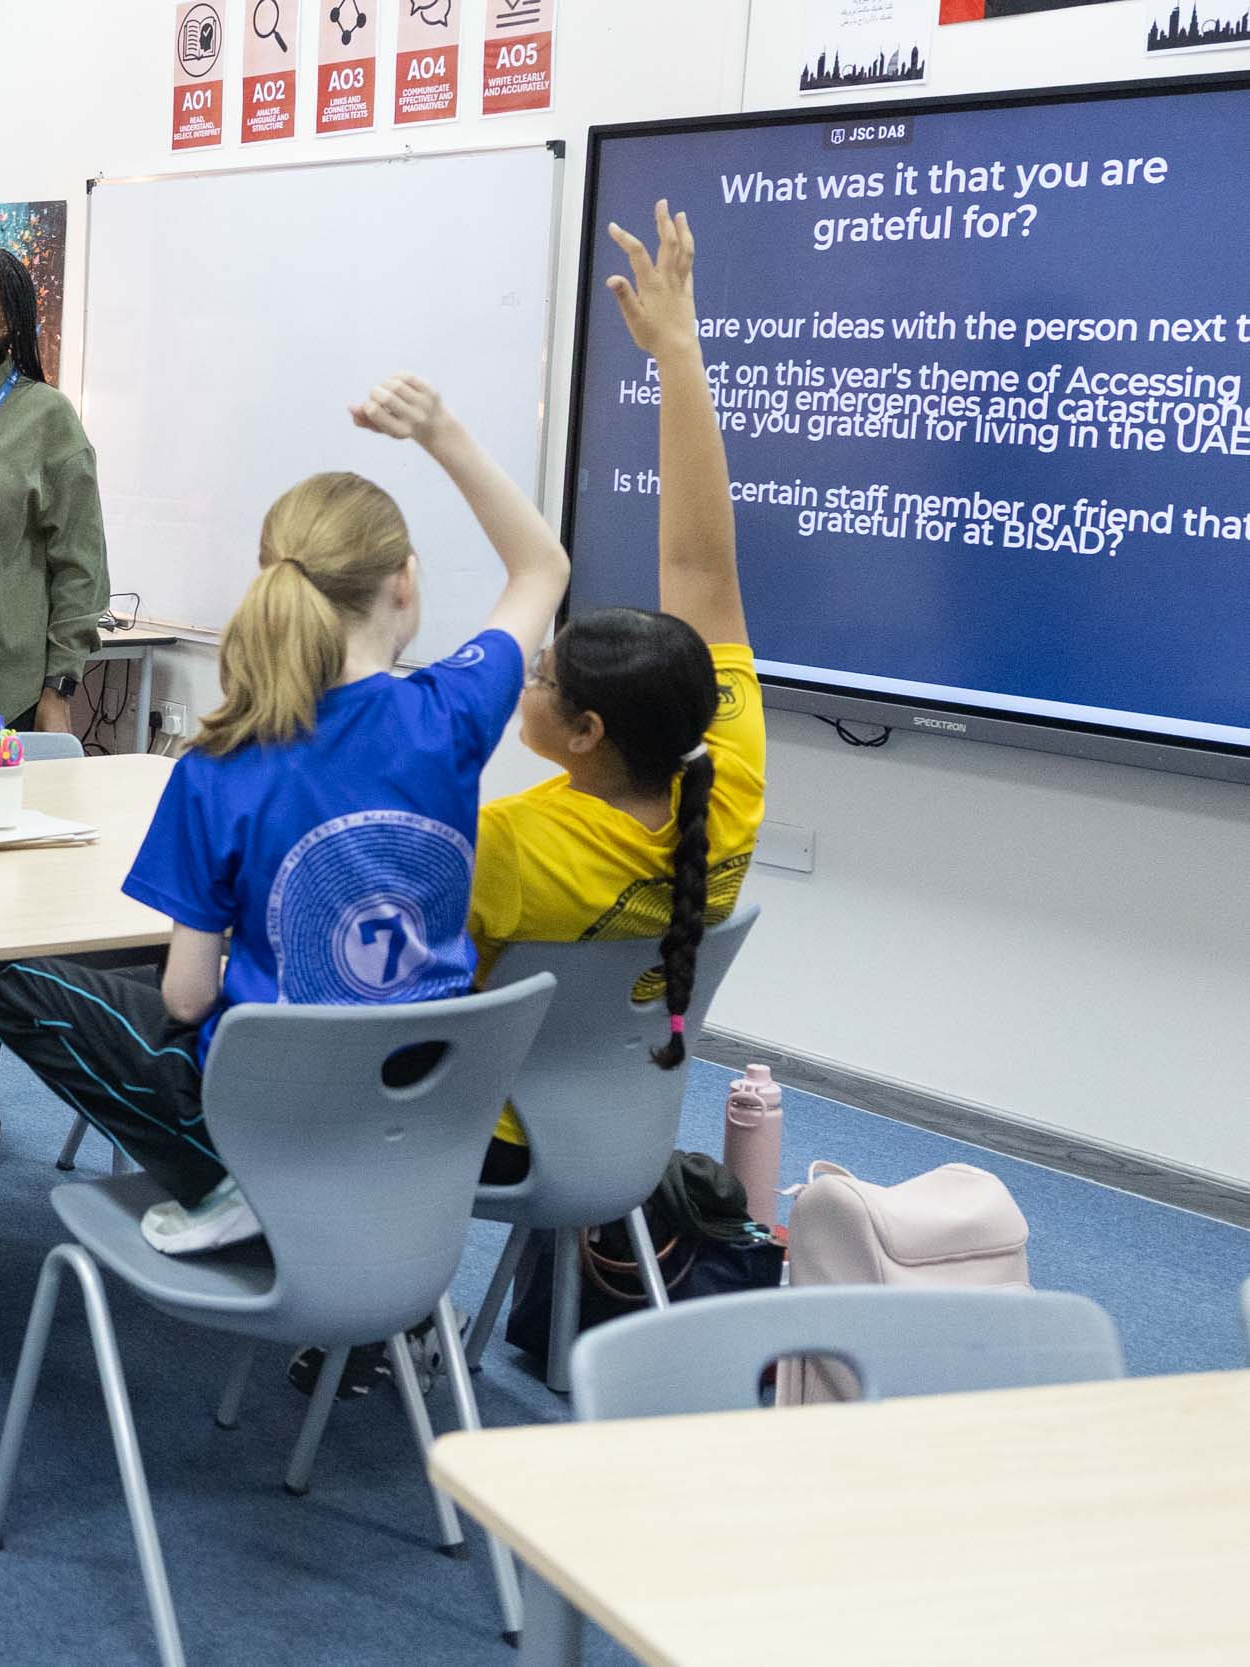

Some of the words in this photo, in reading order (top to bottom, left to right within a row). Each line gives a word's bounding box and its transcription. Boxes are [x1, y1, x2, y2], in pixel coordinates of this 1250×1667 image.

[407, 55, 447, 80] AO4
[496, 43, 538, 70] AO5
[252, 79, 286, 103] AO2
[328, 67, 365, 92] AO3
[402, 83, 450, 97] COMMUNICATE
[484, 87, 501, 97] AND
[501, 81, 550, 95] ACCURATELY
[488, 76, 512, 87] WRITE
[512, 71, 546, 84] CLEARLY
[182, 89, 212, 111] AO1
[323, 102, 367, 115] CONNECTIONS
[348, 95, 361, 104] AND
[399, 94, 439, 105] EFFECTIVELY
[439, 92, 454, 101] AND
[402, 101, 449, 112] IMAGINATIVELY
[277, 112, 289, 121] AND
[322, 112, 350, 123] BETWEEN
[350, 109, 368, 119] TEXTS
[849, 126, 875, 141] JSC
[878, 124, 906, 140] DA8
[721, 171, 808, 203] What
[817, 171, 885, 200] was
[894, 162, 918, 196] it
[928, 160, 1006, 195] that
[1014, 161, 1088, 198] you
[1101, 156, 1168, 186] are
[813, 206, 953, 250] grateful
[963, 204, 1038, 239] for?
[744, 318, 806, 344] your
[812, 312, 885, 340] ideas
[891, 311, 956, 341] with
[965, 312, 1017, 341] the
[1024, 317, 1138, 347] person
[1148, 314, 1227, 342] next
[735, 364, 769, 386] on
[775, 359, 825, 387] this
[830, 362, 912, 395] year's
[918, 362, 1020, 394] theme
[1027, 363, 1062, 394] of
[1065, 366, 1241, 406] Accessing
[795, 388, 981, 419] emergencies
[988, 391, 1050, 420] and
[1057, 395, 1250, 432] catastroph
[751, 412, 800, 437] you
[807, 411, 918, 442] grateful
[926, 411, 967, 443] for
[975, 414, 1059, 452] living
[1068, 418, 1098, 449] in
[1108, 419, 1166, 451] the
[1176, 424, 1250, 455] UAE
[613, 468, 631, 493] Is
[728, 479, 818, 507] certain
[825, 484, 889, 512] staff
[894, 491, 1024, 522] member
[1031, 502, 1066, 526] or
[1073, 498, 1174, 534] friend
[798, 509, 908, 538] grateful
[915, 512, 957, 543] for
[963, 521, 994, 546] at
[1002, 519, 1124, 557] BISAD?
[913, 716, 967, 732] SPECKTRON
[359, 914, 407, 984] 7
